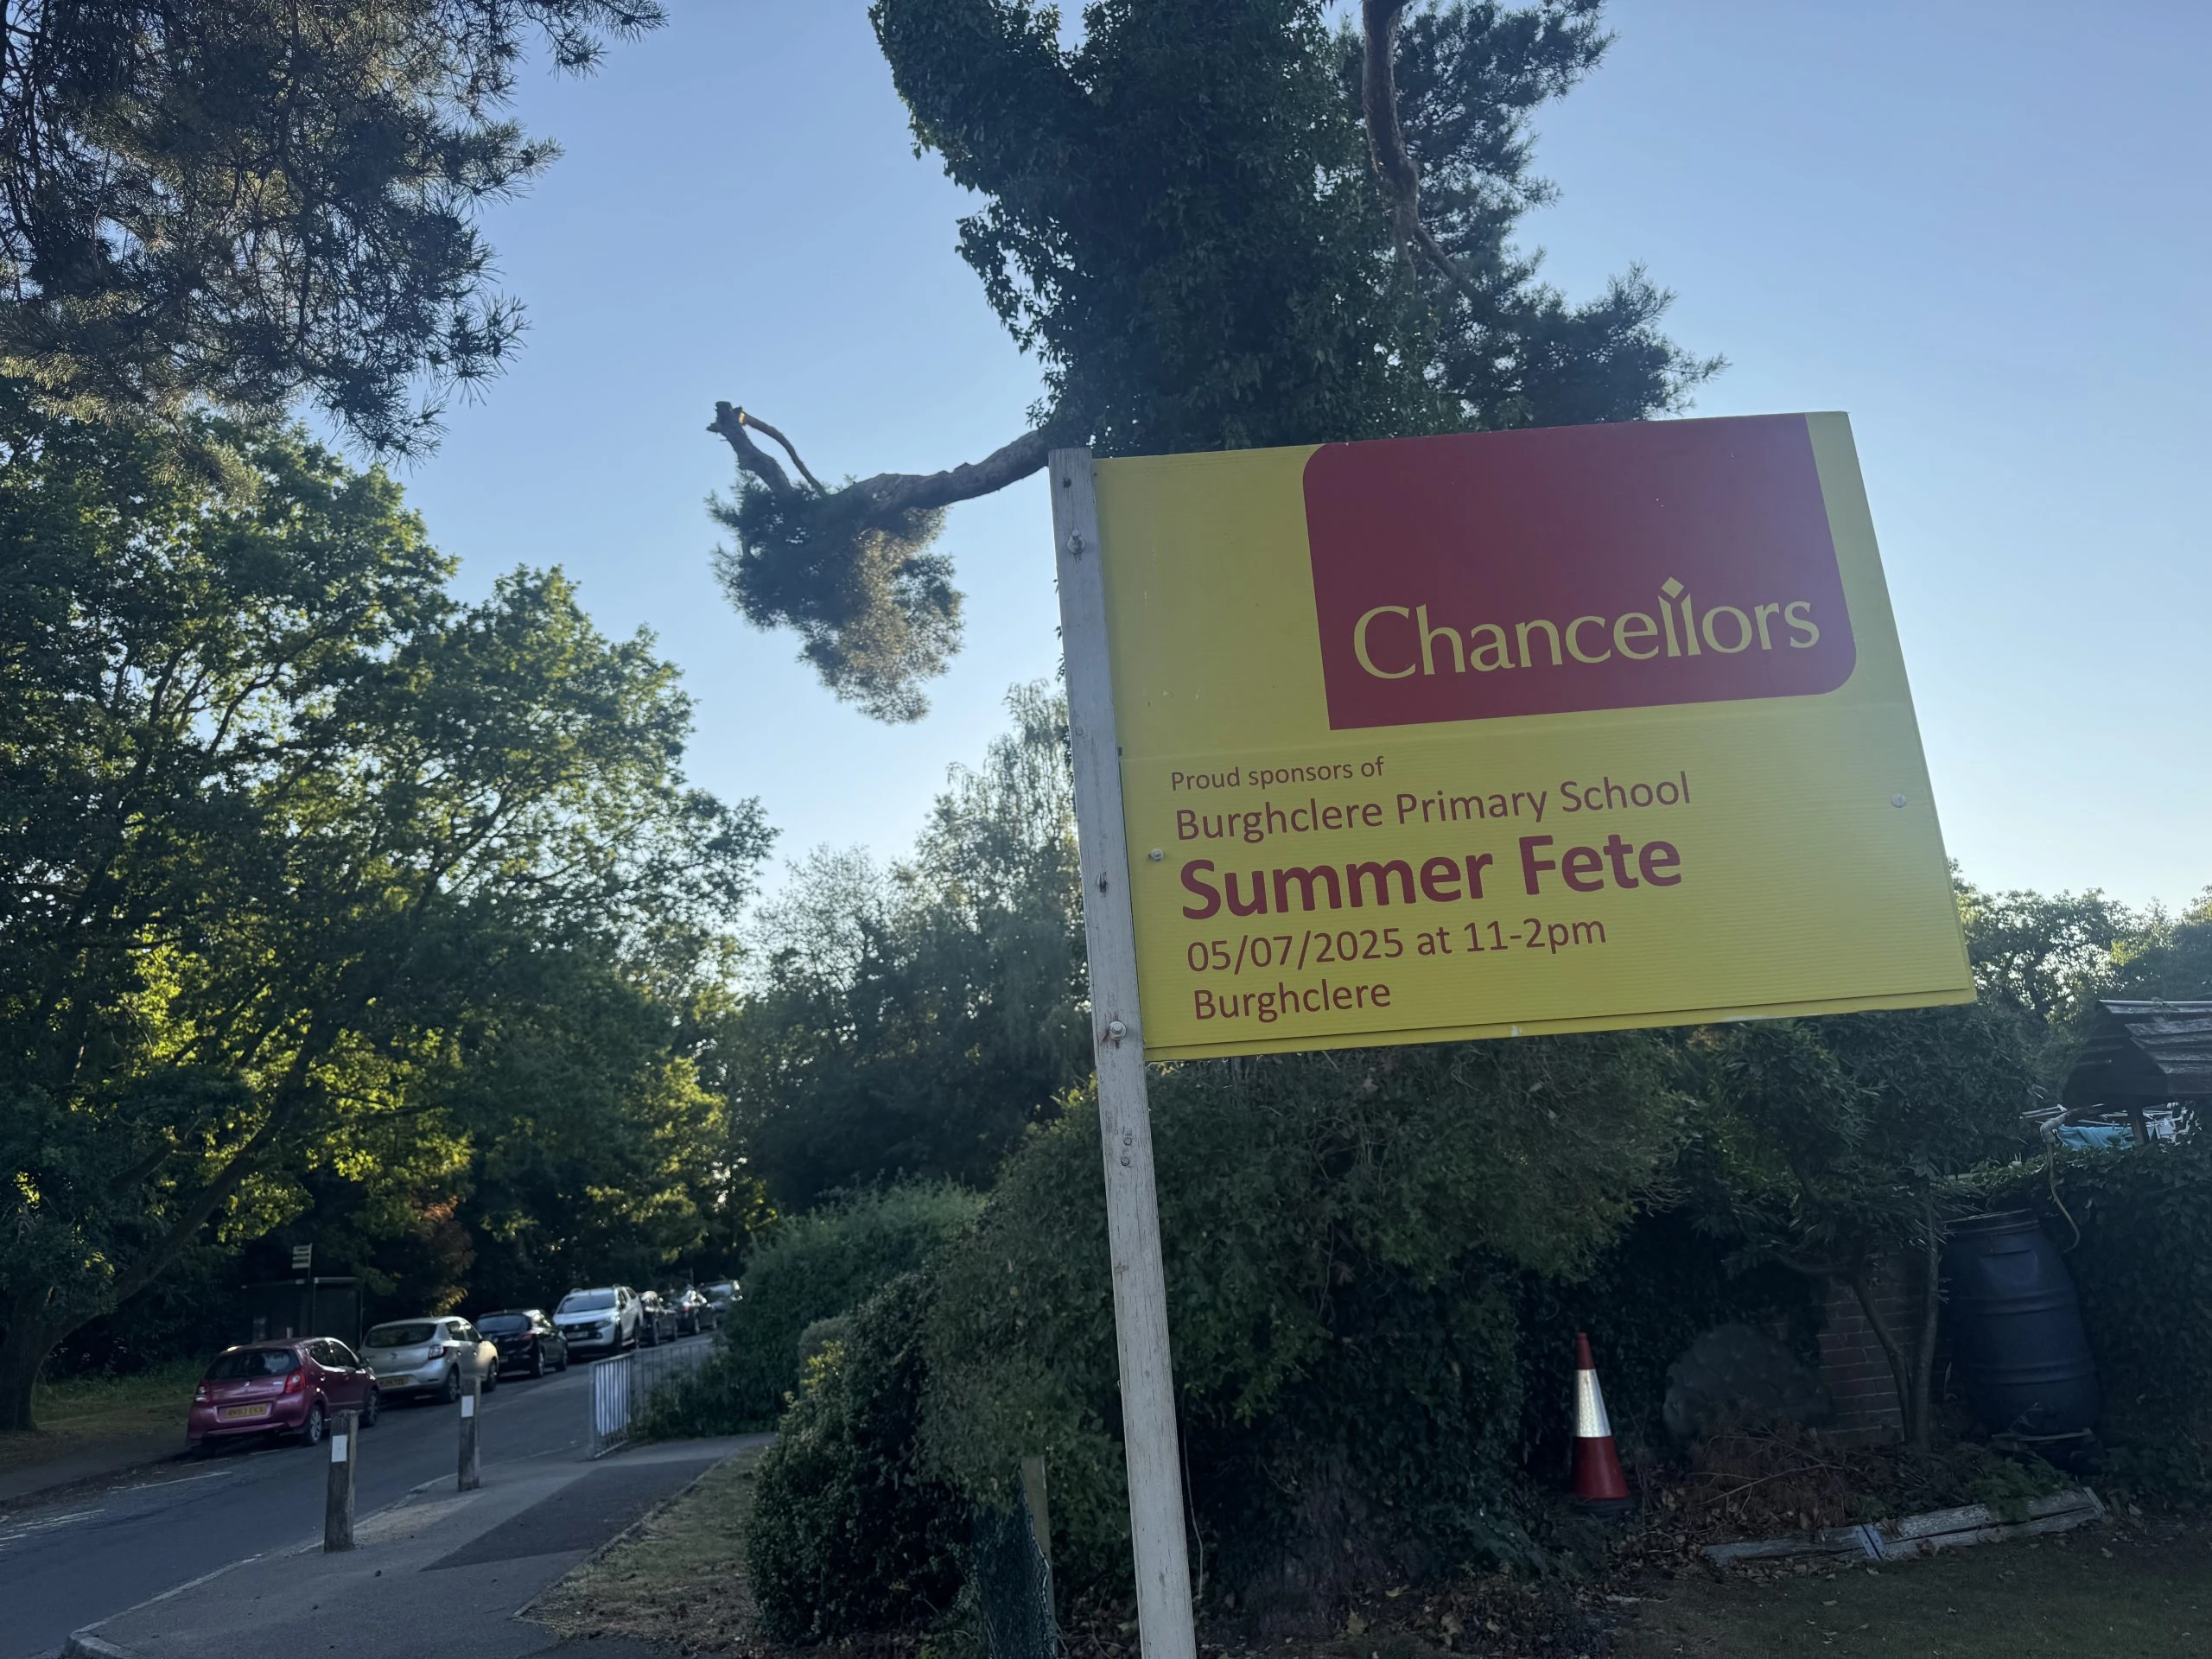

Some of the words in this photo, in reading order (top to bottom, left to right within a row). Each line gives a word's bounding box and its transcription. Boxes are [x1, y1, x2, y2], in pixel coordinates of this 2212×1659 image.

[1353, 576, 1821, 679] Chancellors
[1171, 766, 1241, 791] Proud
[1248, 764, 1353, 790] sponsors
[1360, 755, 1385, 778] of
[1176, 798, 1383, 844] Burghclere
[1396, 790, 1548, 825] Primary
[1560, 771, 1690, 813] School
[1180, 853, 1494, 920] Summer
[1518, 834, 1681, 896] Fete
[1187, 927, 1404, 976] 05/07/2025
[1416, 926, 1452, 957] at
[1464, 918, 1606, 955] 11-2pm
[1194, 978, 1391, 1024] Burghclere
